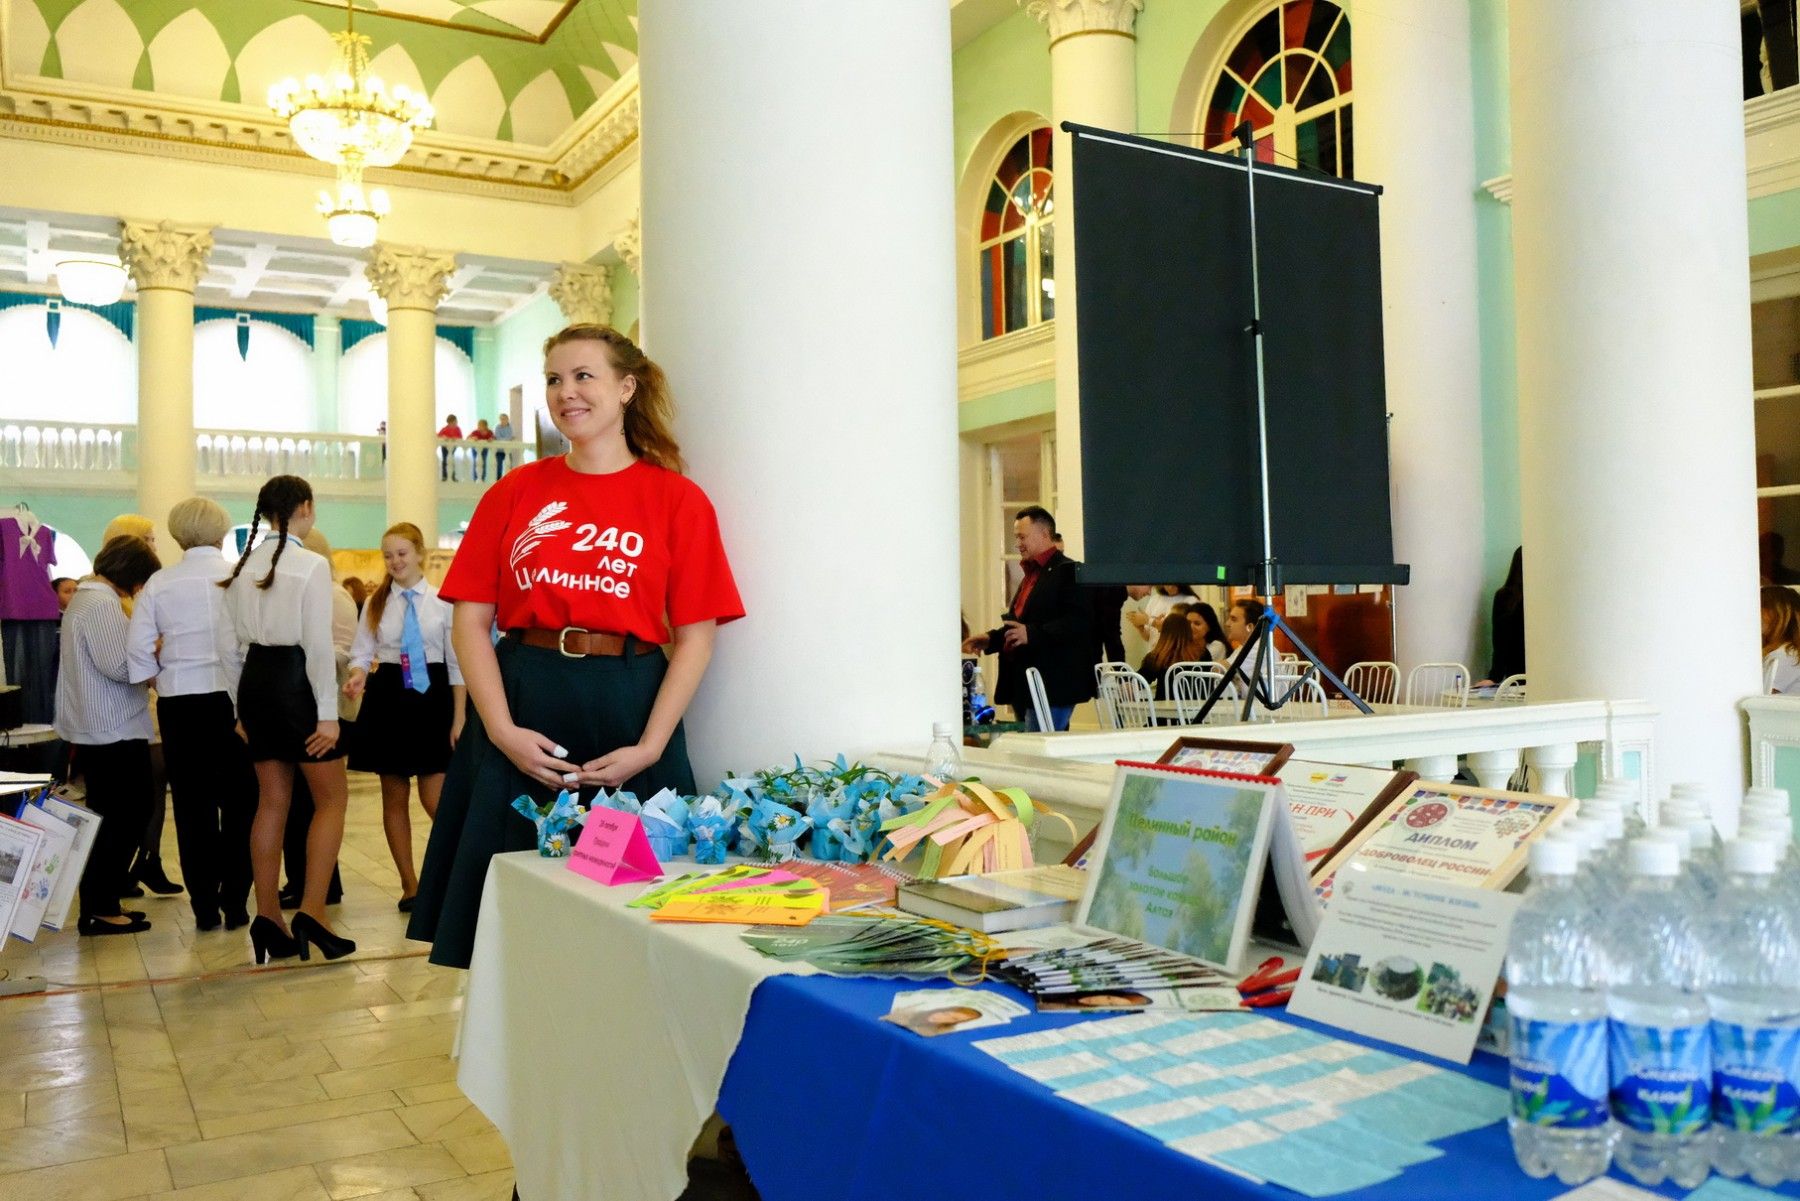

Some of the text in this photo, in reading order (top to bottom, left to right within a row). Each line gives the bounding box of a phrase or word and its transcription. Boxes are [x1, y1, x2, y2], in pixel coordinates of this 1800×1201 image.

[572, 523, 644, 558] 240
[597, 556, 638, 578] лет
[1288, 803, 1338, 818] Н-ПРИ
[1405, 832, 1479, 851] ДИПЛОМ
